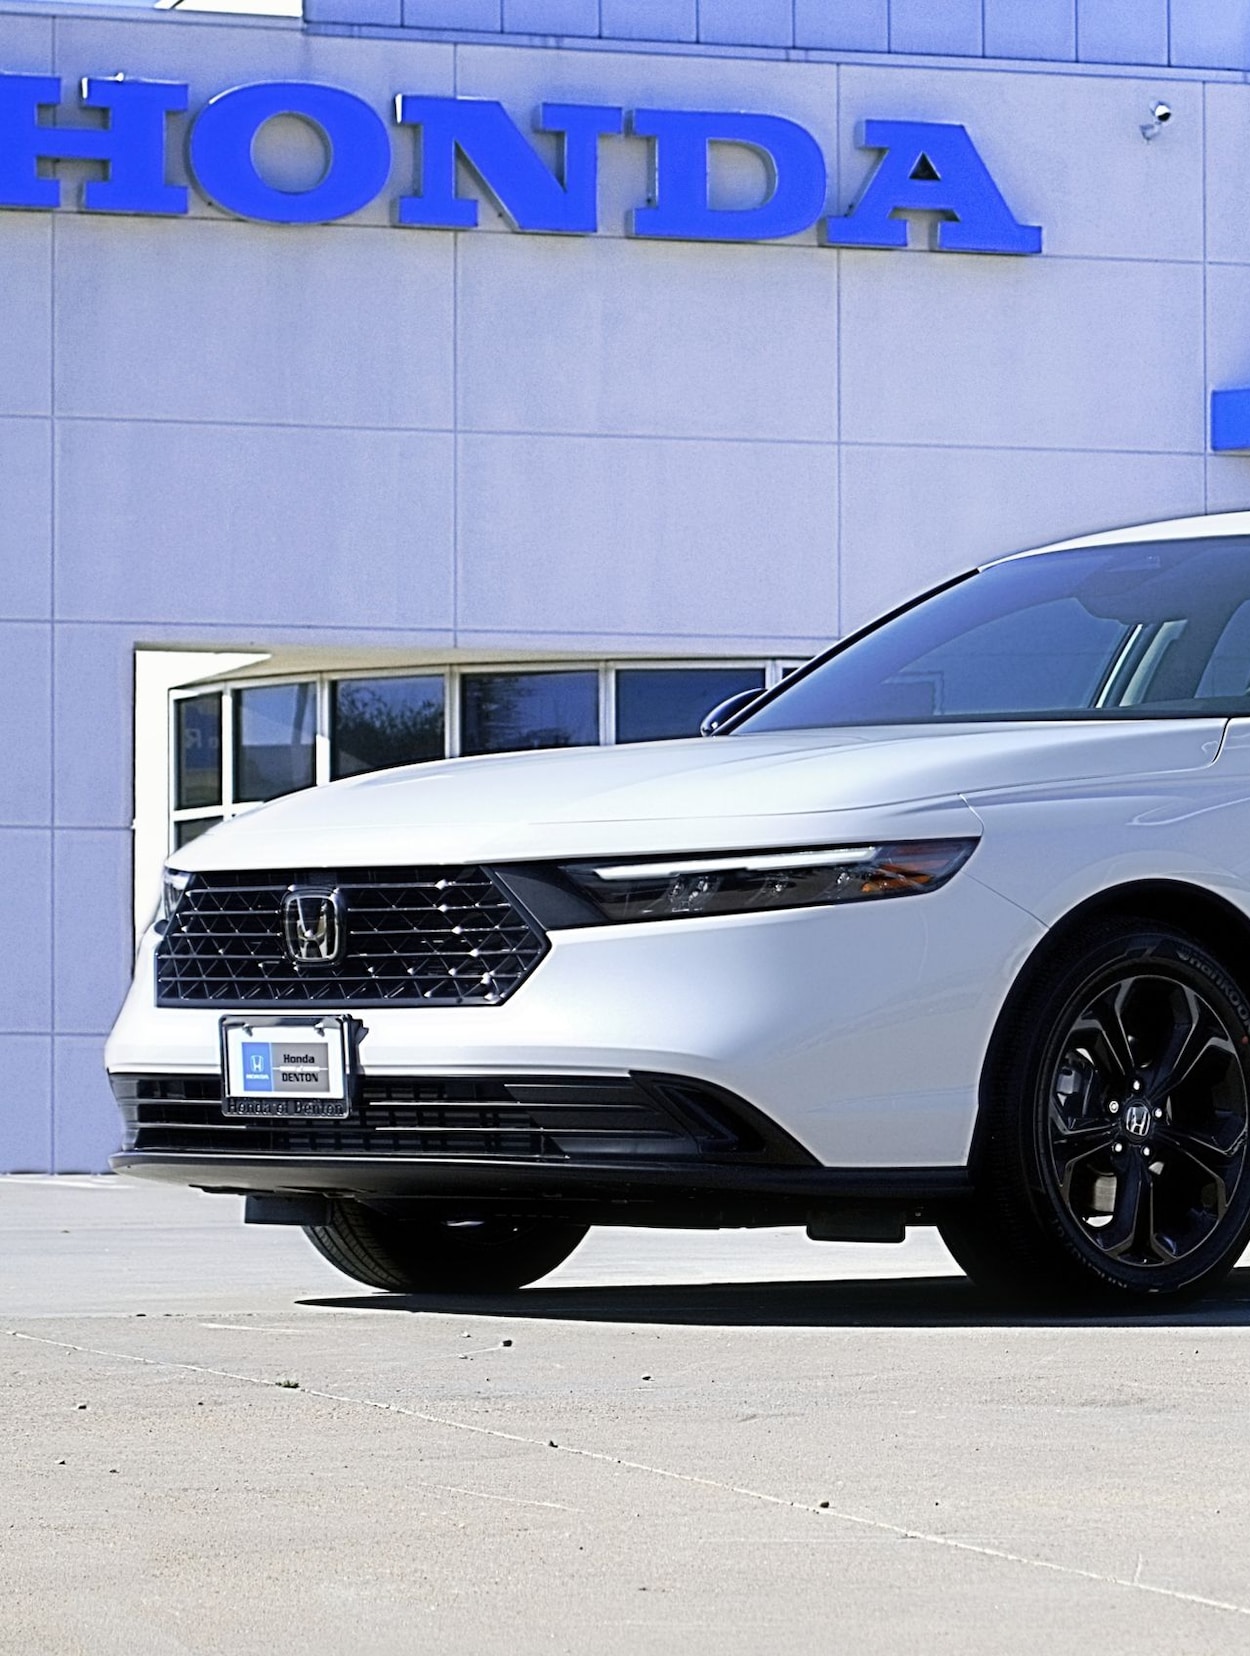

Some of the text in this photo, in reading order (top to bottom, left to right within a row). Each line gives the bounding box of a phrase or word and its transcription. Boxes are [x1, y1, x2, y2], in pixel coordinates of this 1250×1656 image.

[0, 71, 1043, 255] HONDA
[283, 1054, 315, 1064] Honda
[281, 1072, 319, 1082] DENTON
